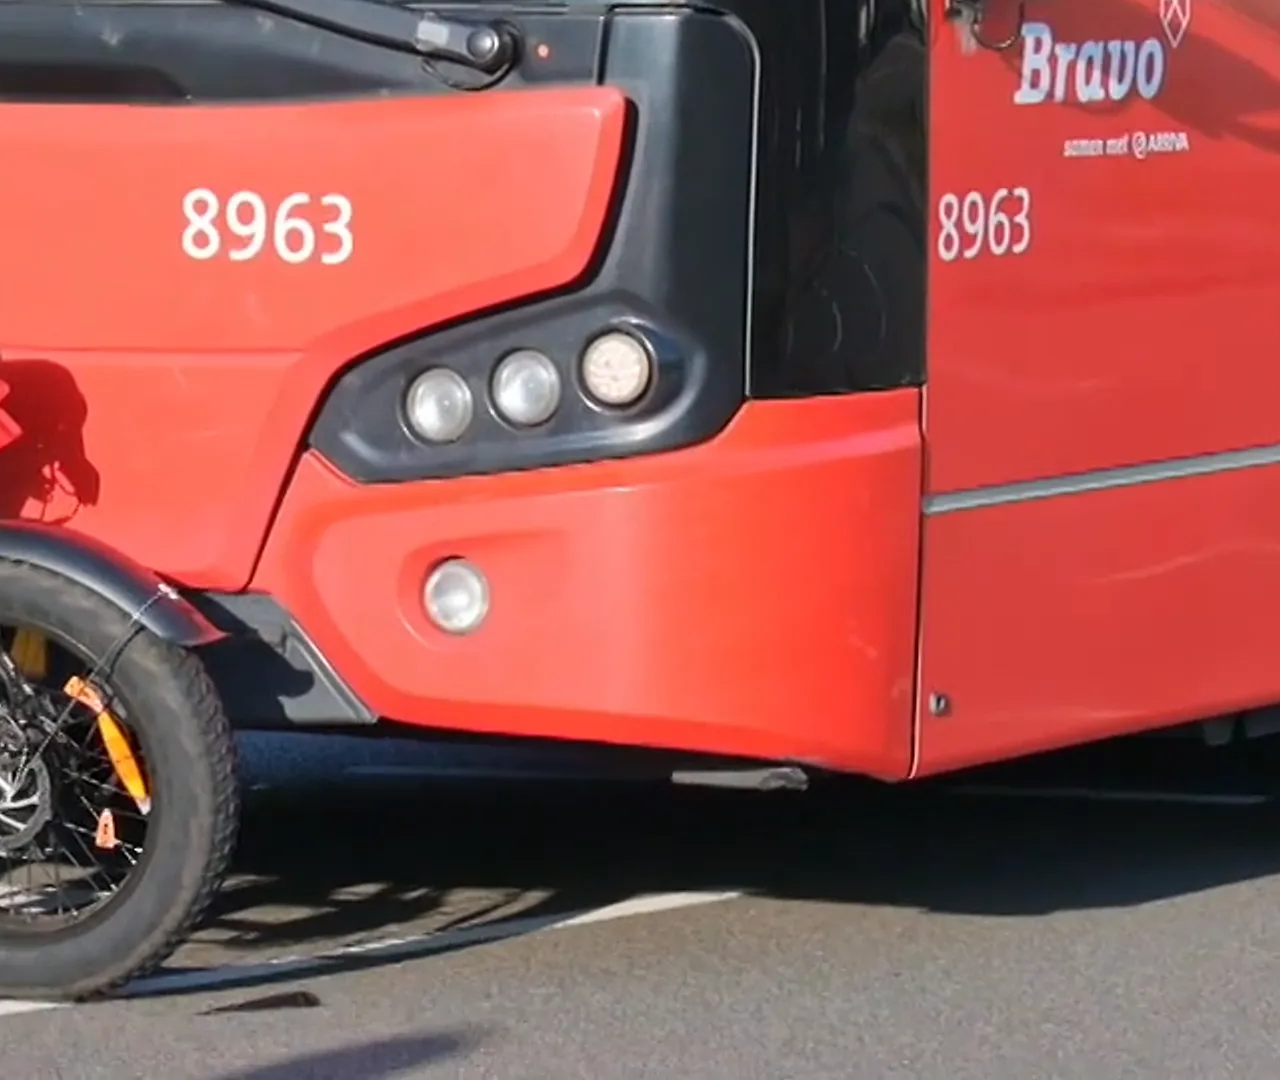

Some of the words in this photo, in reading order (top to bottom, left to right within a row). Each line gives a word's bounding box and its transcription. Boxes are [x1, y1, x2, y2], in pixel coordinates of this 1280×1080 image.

[1014, 21, 1164, 105] Bravo
[181, 187, 354, 265] 8963
[937, 185, 1030, 262] 8963
